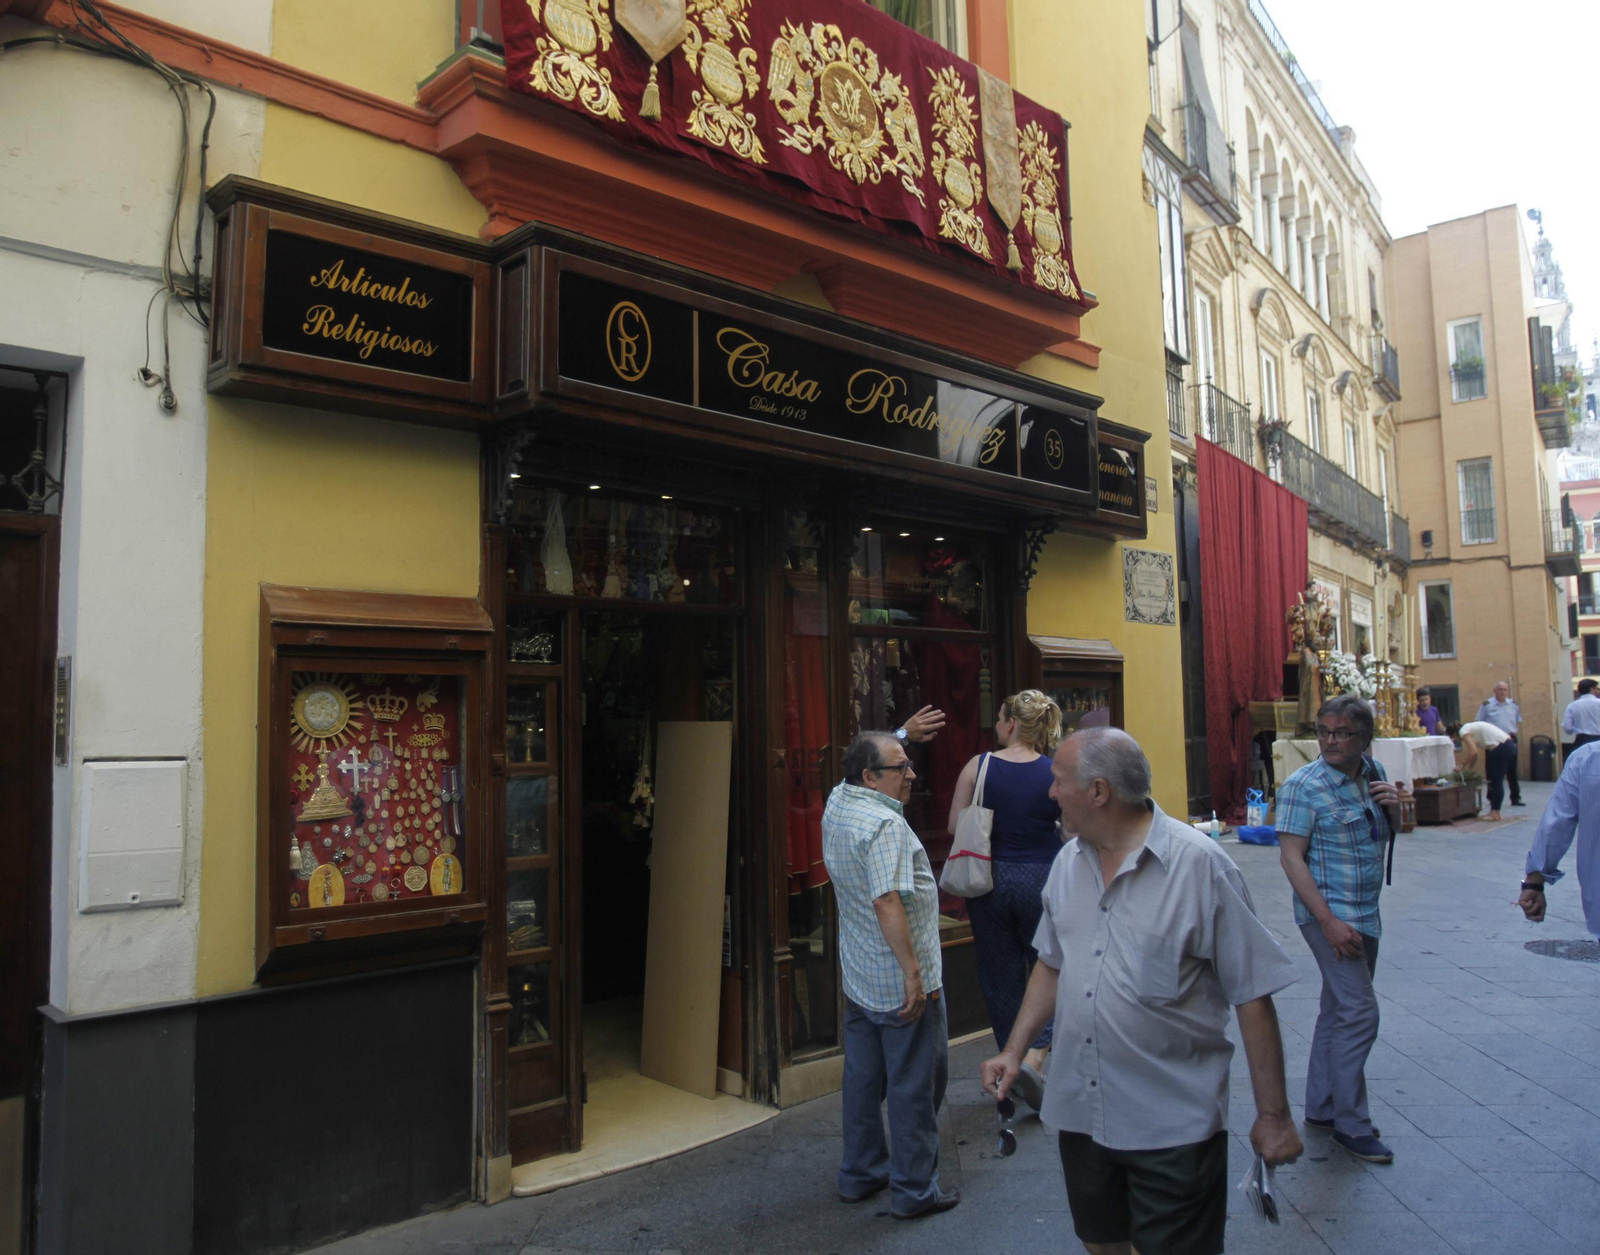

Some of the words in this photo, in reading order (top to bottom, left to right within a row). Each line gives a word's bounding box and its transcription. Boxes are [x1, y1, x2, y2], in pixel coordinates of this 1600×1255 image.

[310, 259, 434, 309] Artículos
[302, 304, 439, 359] Religiosos
[716, 327, 821, 402] Casa
[846, 368, 1006, 464] Rodríguez
[749, 395, 778, 414] Desde
[781, 405, 807, 420] 1913
[1047, 437, 1061, 458] 35
